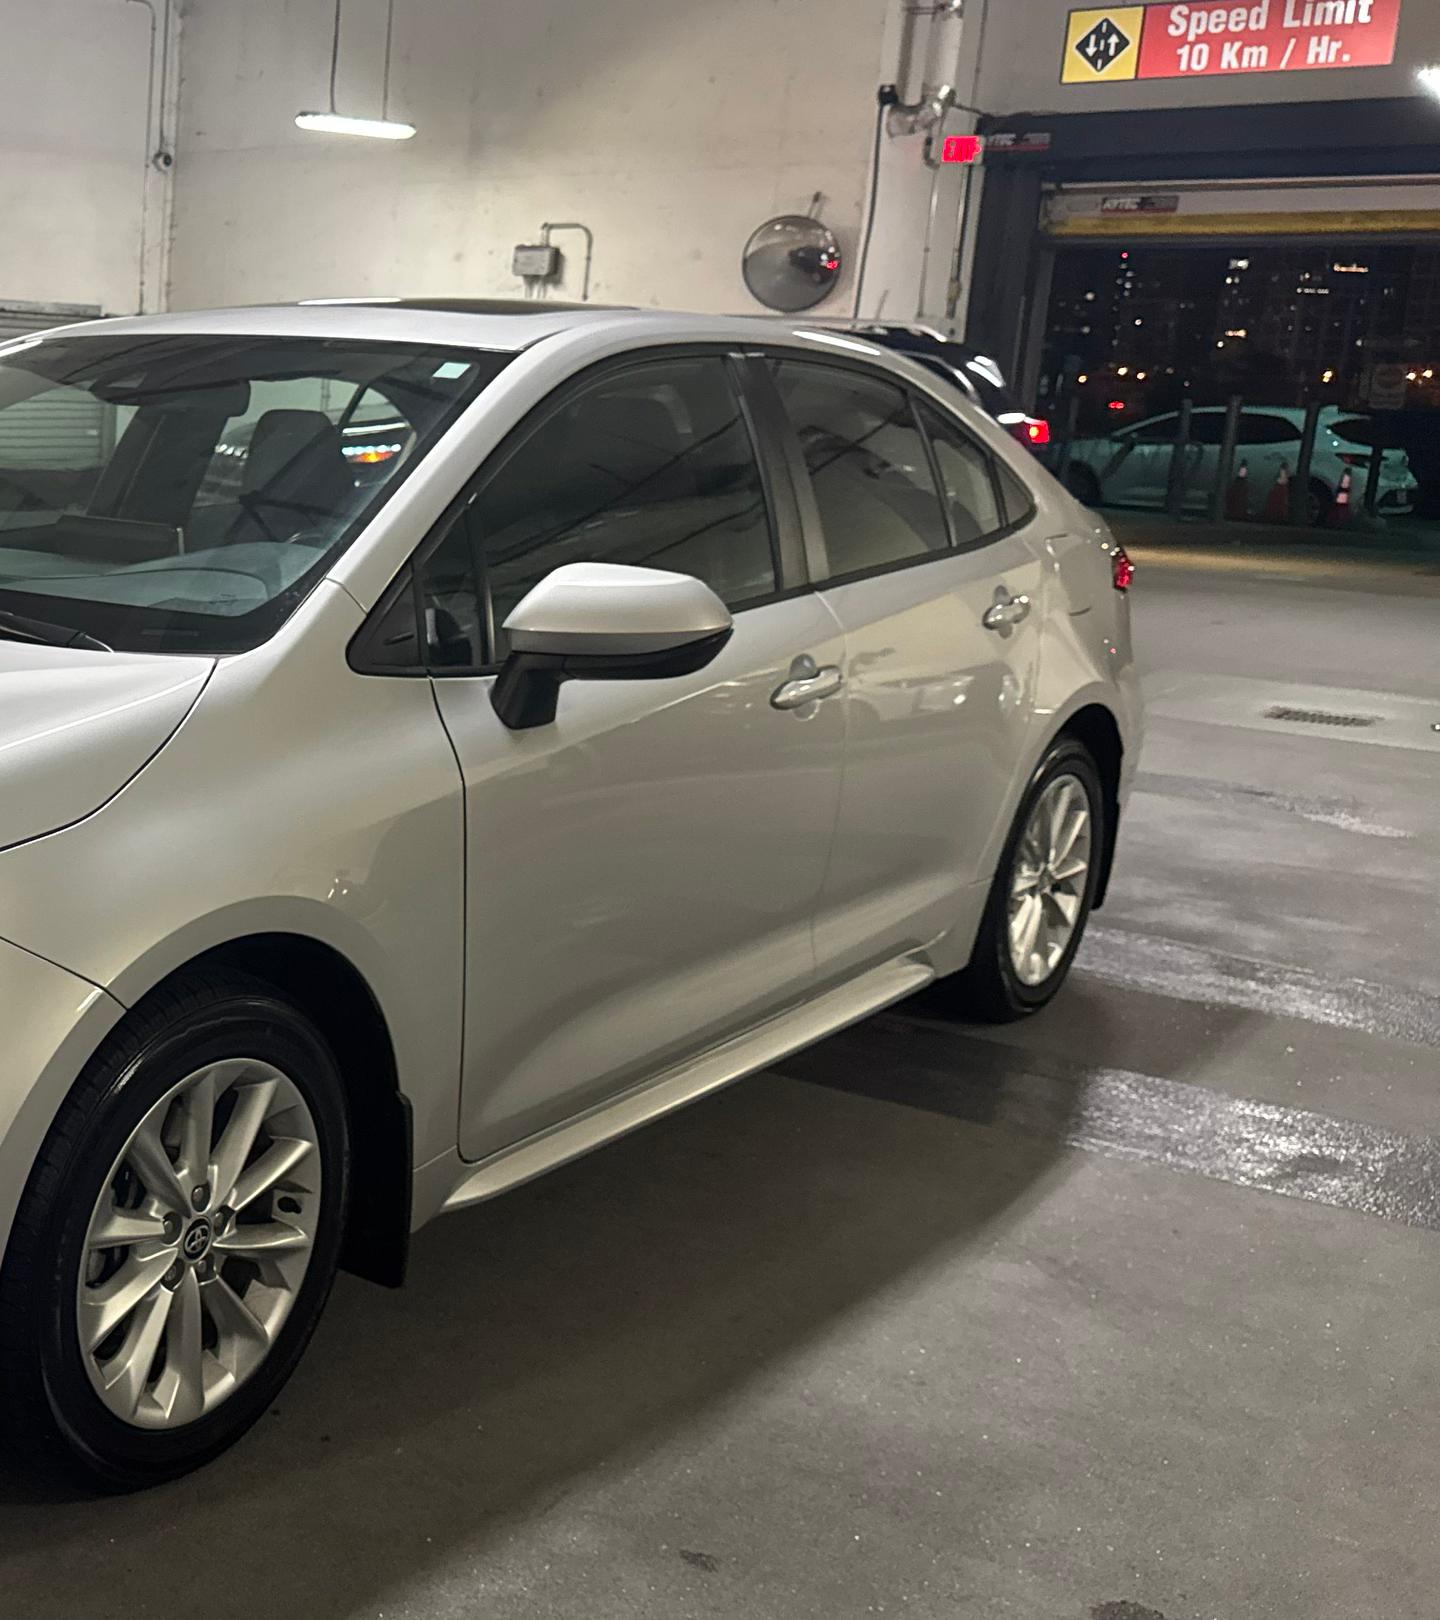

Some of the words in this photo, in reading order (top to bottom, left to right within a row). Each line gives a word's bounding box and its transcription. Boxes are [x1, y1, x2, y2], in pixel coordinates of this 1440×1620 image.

[1168, 0, 1269, 41] Speed
[1283, 0, 1374, 28] Limit
[1176, 43, 1210, 72] 10
[1220, 40, 1269, 69] Km
[1279, 37, 1297, 70] /
[1306, 35, 1352, 65] Hr.
